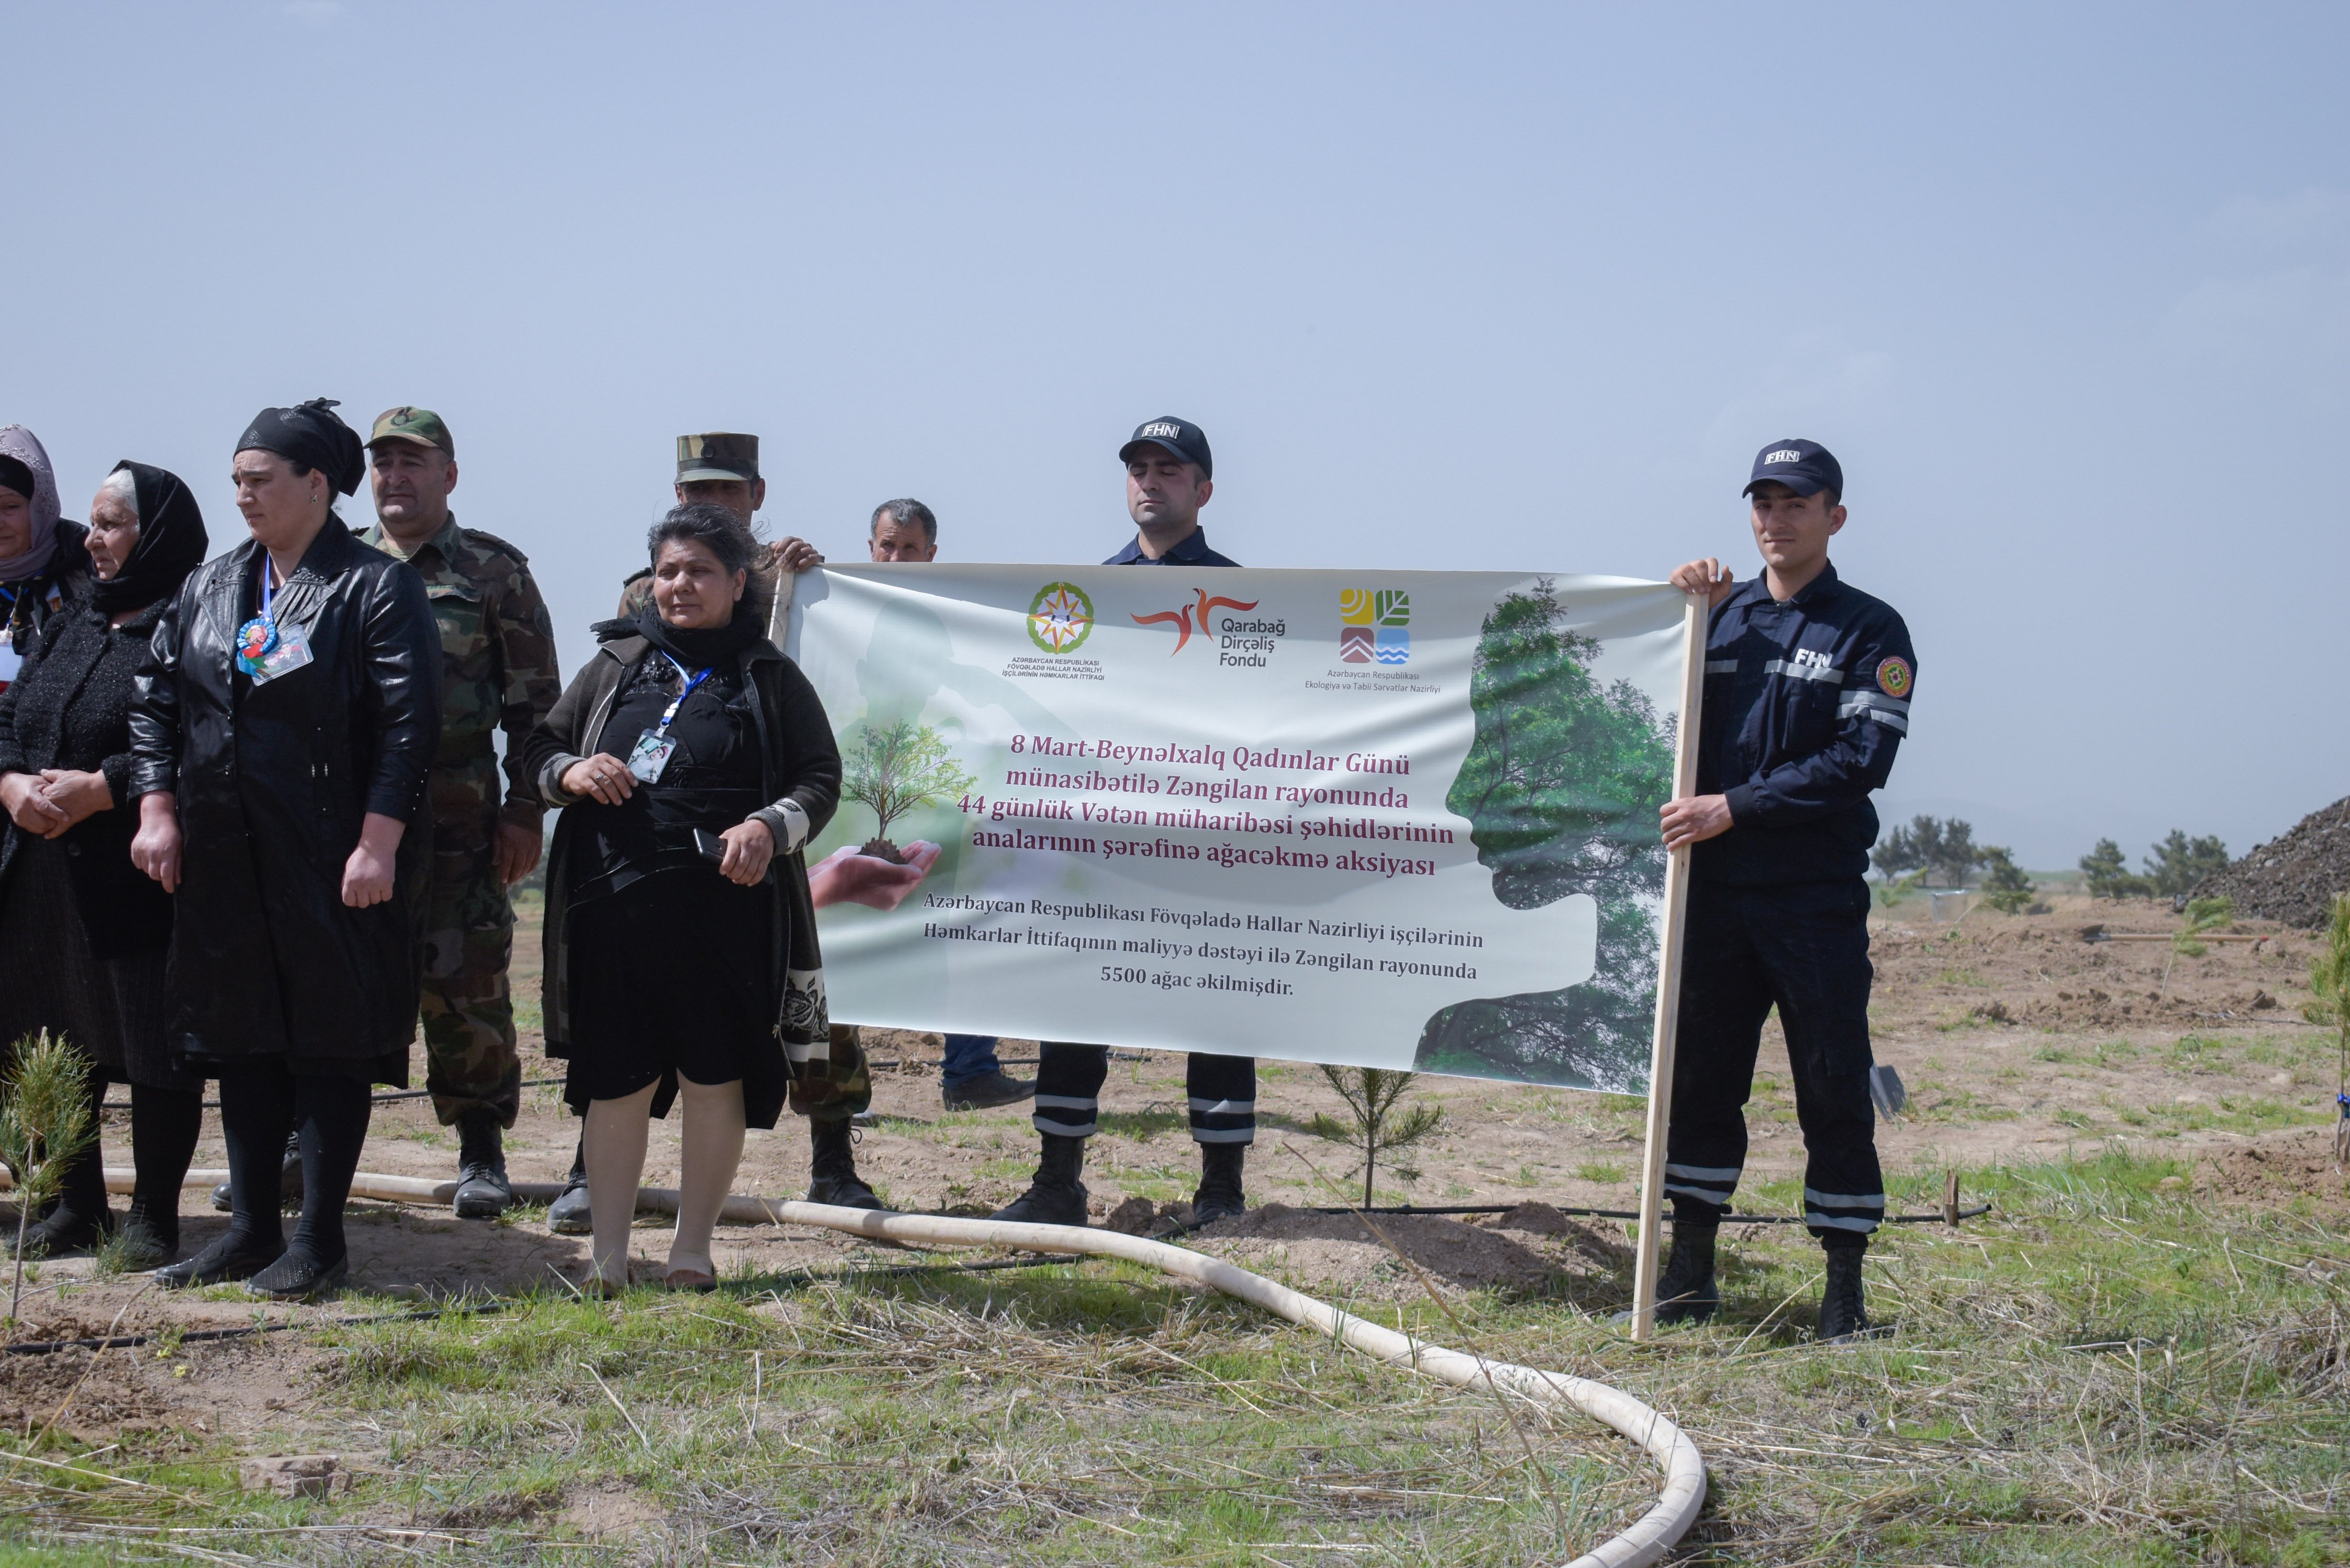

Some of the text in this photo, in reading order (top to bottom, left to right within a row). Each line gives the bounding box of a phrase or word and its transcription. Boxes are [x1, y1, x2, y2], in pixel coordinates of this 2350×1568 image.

[1145, 424, 1177, 438] FHN
[1767, 451, 1797, 462] FHN
[1222, 618, 1285, 637] Qarabağ
[1222, 635, 1274, 653] Dirçəliş
[1220, 652, 1266, 667] Fondu
[1794, 649, 1833, 669] FHN
[1327, 670, 1419, 681] Azərbaycan Respublikası
[1305, 681, 1340, 690] Ekologiya
[1374, 683, 1408, 691] Sərvətlər
[1410, 685, 1441, 694] Nazirliyi
[1011, 735, 1410, 775] 8 Mart-Beynəlxalq Qadınlar Günü
[1006, 767, 1408, 808] münasibətilə Zəngilan rayonunda
[957, 794, 1454, 844] 44 günlük Vətən müharibəsi şəhidlərinin
[973, 828, 1435, 878] analarının şərəfinə ağacəkmə aksiyası
[923, 892, 1482, 948] Azərbaycan Respublikası Fövqəladə Hallar Nazirliyi işçilərinin
[924, 923, 1477, 979] Həmkarlar İttifaqının maliyyə dəstəyi ilə Zəngilan rayonunda
[1101, 966, 1293, 997] 5500 ağac əkilmişdir.
